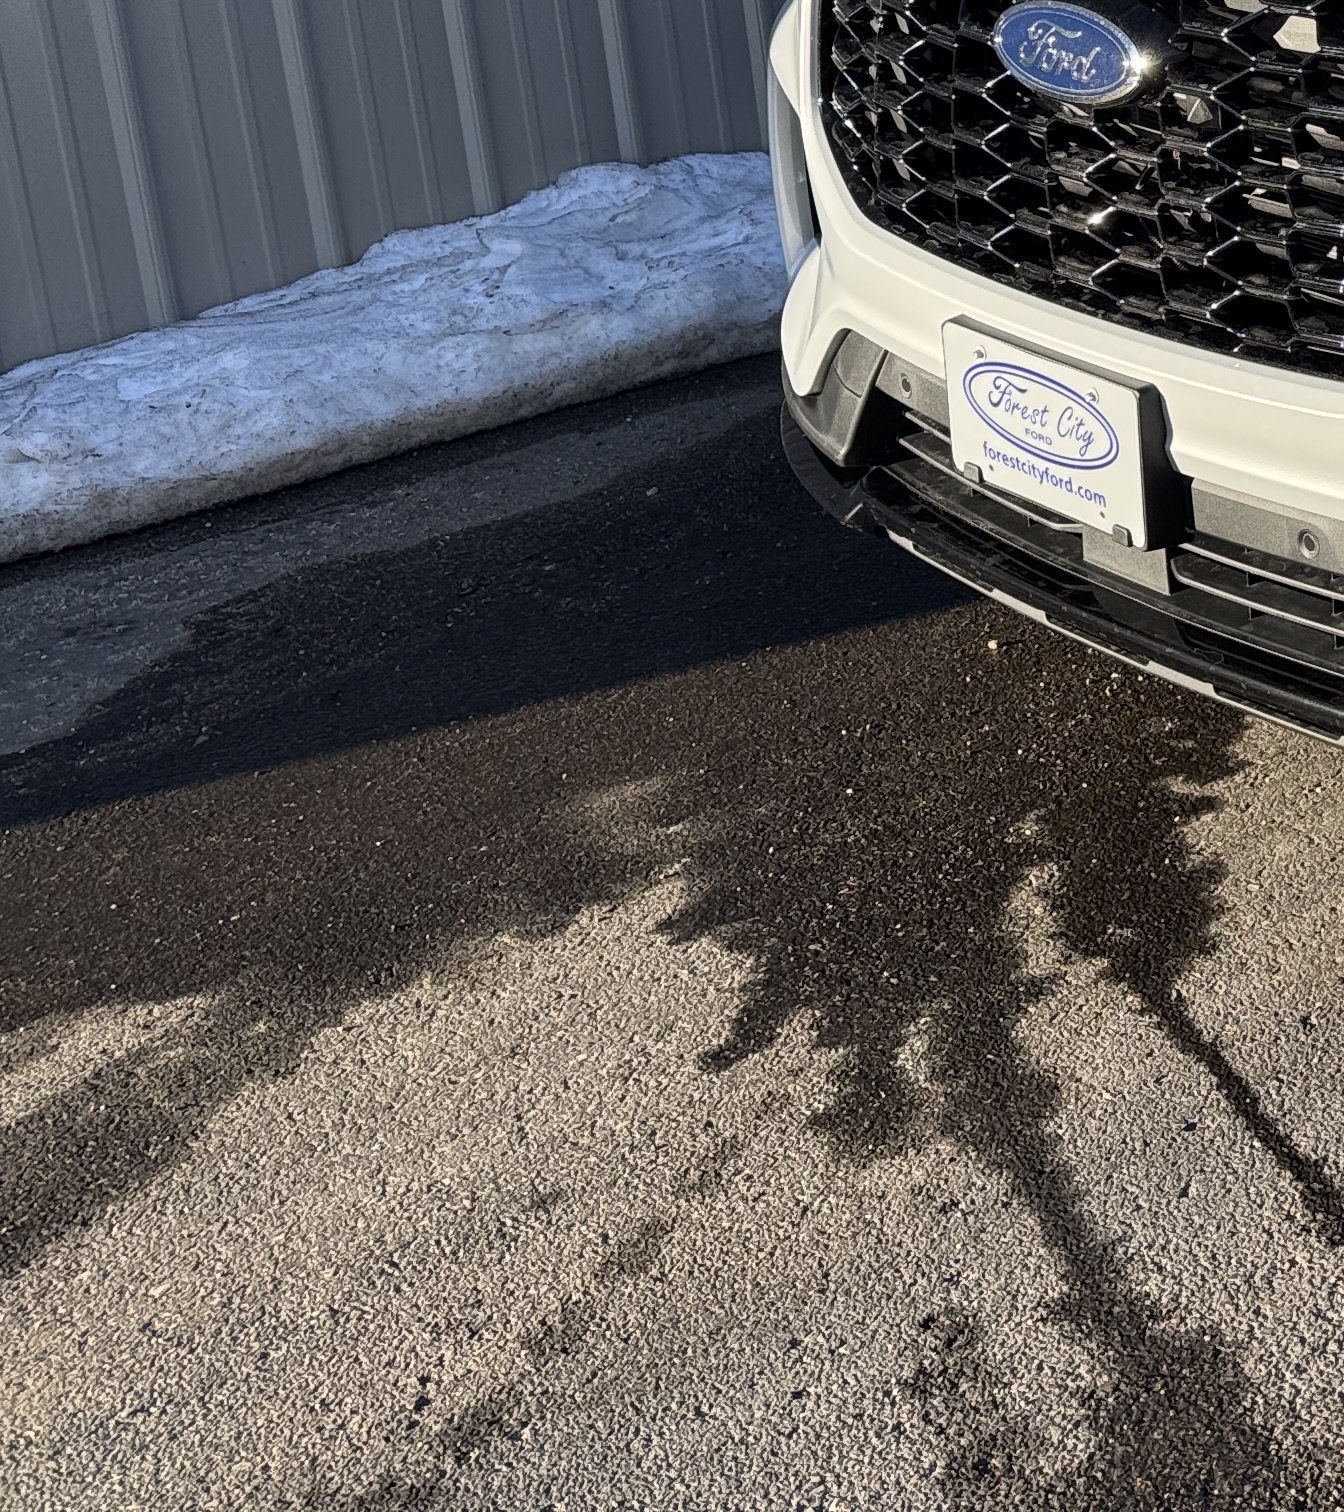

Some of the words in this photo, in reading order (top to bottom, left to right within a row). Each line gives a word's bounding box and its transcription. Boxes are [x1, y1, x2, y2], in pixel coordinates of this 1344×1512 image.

[1019, 18, 1099, 83] Ford
[988, 375, 1050, 428] Forest
[1056, 406, 1095, 457] City
[1024, 427, 1053, 446] FORD
[982, 441, 1107, 508] forestcityford.com
